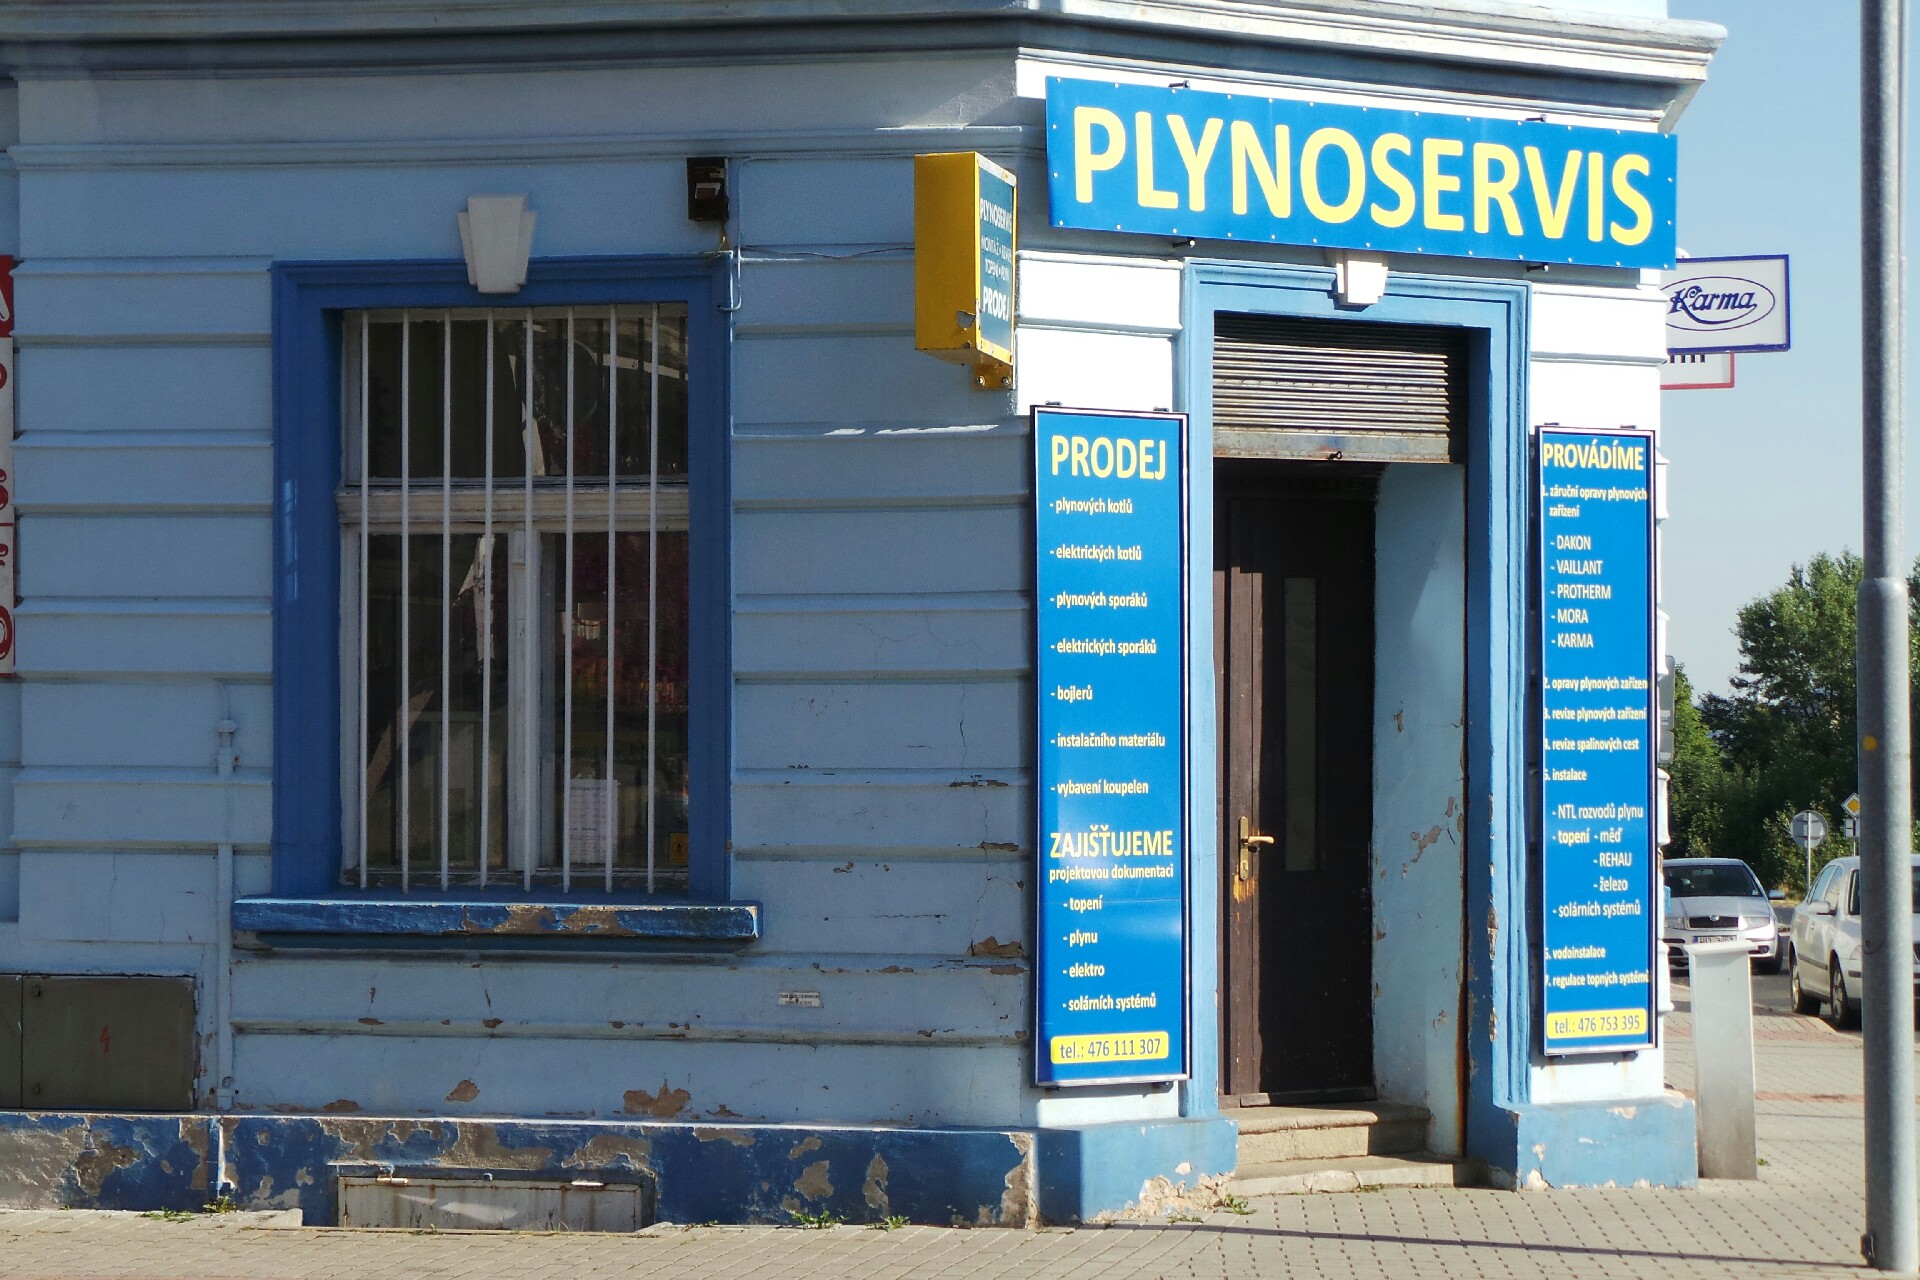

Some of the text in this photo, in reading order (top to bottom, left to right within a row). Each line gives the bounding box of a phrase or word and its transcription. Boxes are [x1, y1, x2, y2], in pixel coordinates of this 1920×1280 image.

[1072, 104, 1653, 247] PLYNOSERVIS
[983, 286, 1009, 322] PRODEJ
[1667, 285, 1758, 325] Karma
[1052, 435, 1166, 480] PRODEJ
[1542, 439, 1645, 471] PROVÁDÍME
[1550, 485, 1579, 498] záruční
[1579, 488, 1607, 501] opravy
[1608, 486, 1647, 502] plynových
[1056, 497, 1106, 515] plynových
[1108, 498, 1132, 513] kotlů
[1549, 504, 1579, 517] zařízení
[1557, 535, 1591, 550] DAKON
[1056, 544, 1115, 562] elektrických
[1117, 545, 1142, 560] kotlů
[1557, 560, 1603, 574] VAILLANT
[1057, 591, 1106, 609] plynových
[1109, 592, 1147, 609] sporáků
[1558, 584, 1611, 599] PROTHERM
[1558, 609, 1588, 623] MORA
[1057, 638, 1116, 656] elektrických
[1118, 639, 1156, 656] sporáků
[1558, 633, 1593, 647] KARMA
[1544, 677, 1648, 691] 2. opravy plynových zařízen
[1058, 685, 1092, 703] bojlerů
[1552, 708, 1576, 719] revize
[1576, 707, 1617, 721] plynových
[1617, 707, 1647, 721] zařízení
[1058, 733, 1116, 747] instalačního
[1119, 733, 1165, 747] materiálu
[1552, 738, 1576, 750] revize
[1576, 738, 1623, 752] spalinových
[1622, 739, 1639, 750] cest
[1553, 769, 1587, 780] instalace
[1057, 780, 1101, 797] vybavení
[1103, 780, 1148, 796] koupelen
[1558, 804, 1576, 818] NTL
[1578, 803, 1616, 819] rozvodů
[1618, 803, 1643, 821] plynu
[1050, 824, 1173, 860] ZAJIŠŤUJEME
[1558, 828, 1590, 846] topení
[1600, 828, 1622, 842] měď
[1600, 852, 1632, 867] REHAU
[1050, 863, 1173, 883] projektovou dokumentaci
[1600, 877, 1628, 891] železo
[1070, 895, 1103, 913] topení
[1559, 901, 1601, 917] solárních
[1603, 900, 1641, 918] systémů
[1070, 929, 1098, 947] plynu
[1553, 946, 1606, 959] vodoinstalace
[1069, 963, 1105, 977] elektro
[1553, 974, 1587, 989] regulace
[1586, 972, 1619, 987] topných
[1069, 995, 1114, 1011] solárních
[1116, 993, 1156, 1011] systémů
[1555, 1015, 1639, 1033] tel.: 476 753 395
[1060, 1039, 1160, 1058] tel.: 476 111 307
